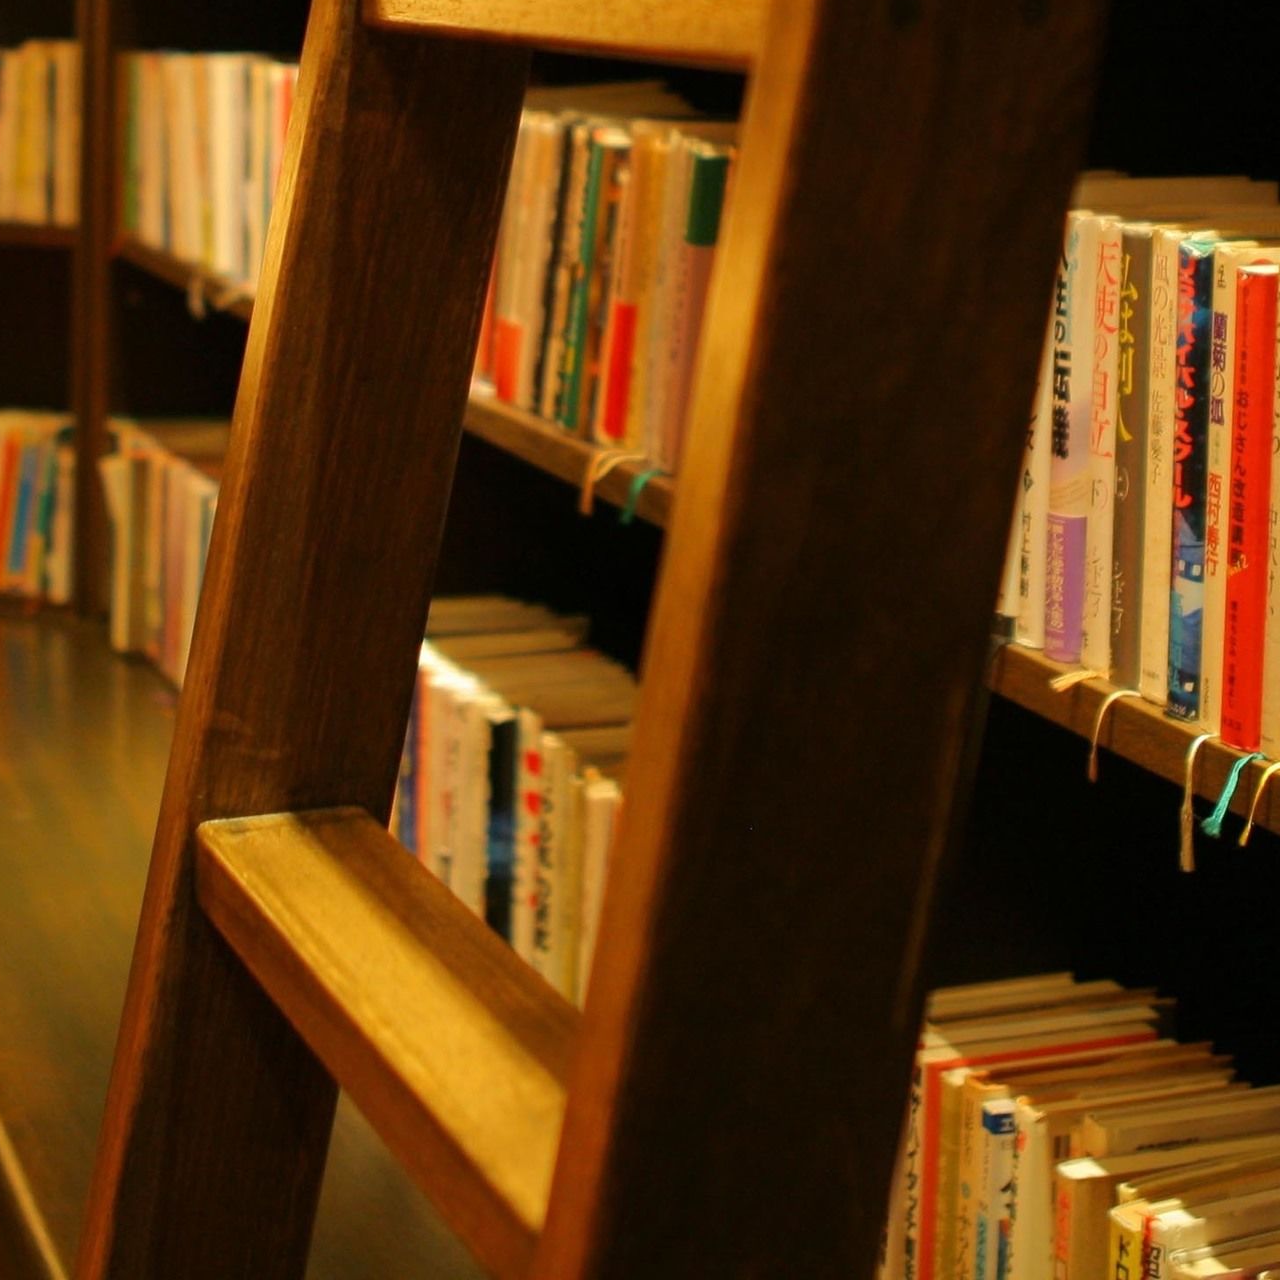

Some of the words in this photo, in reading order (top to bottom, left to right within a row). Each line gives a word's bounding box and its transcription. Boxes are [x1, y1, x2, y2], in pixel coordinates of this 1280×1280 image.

[1090, 241, 1120, 459] 天使の自立
[1206, 471, 1224, 578] 西村寿行
